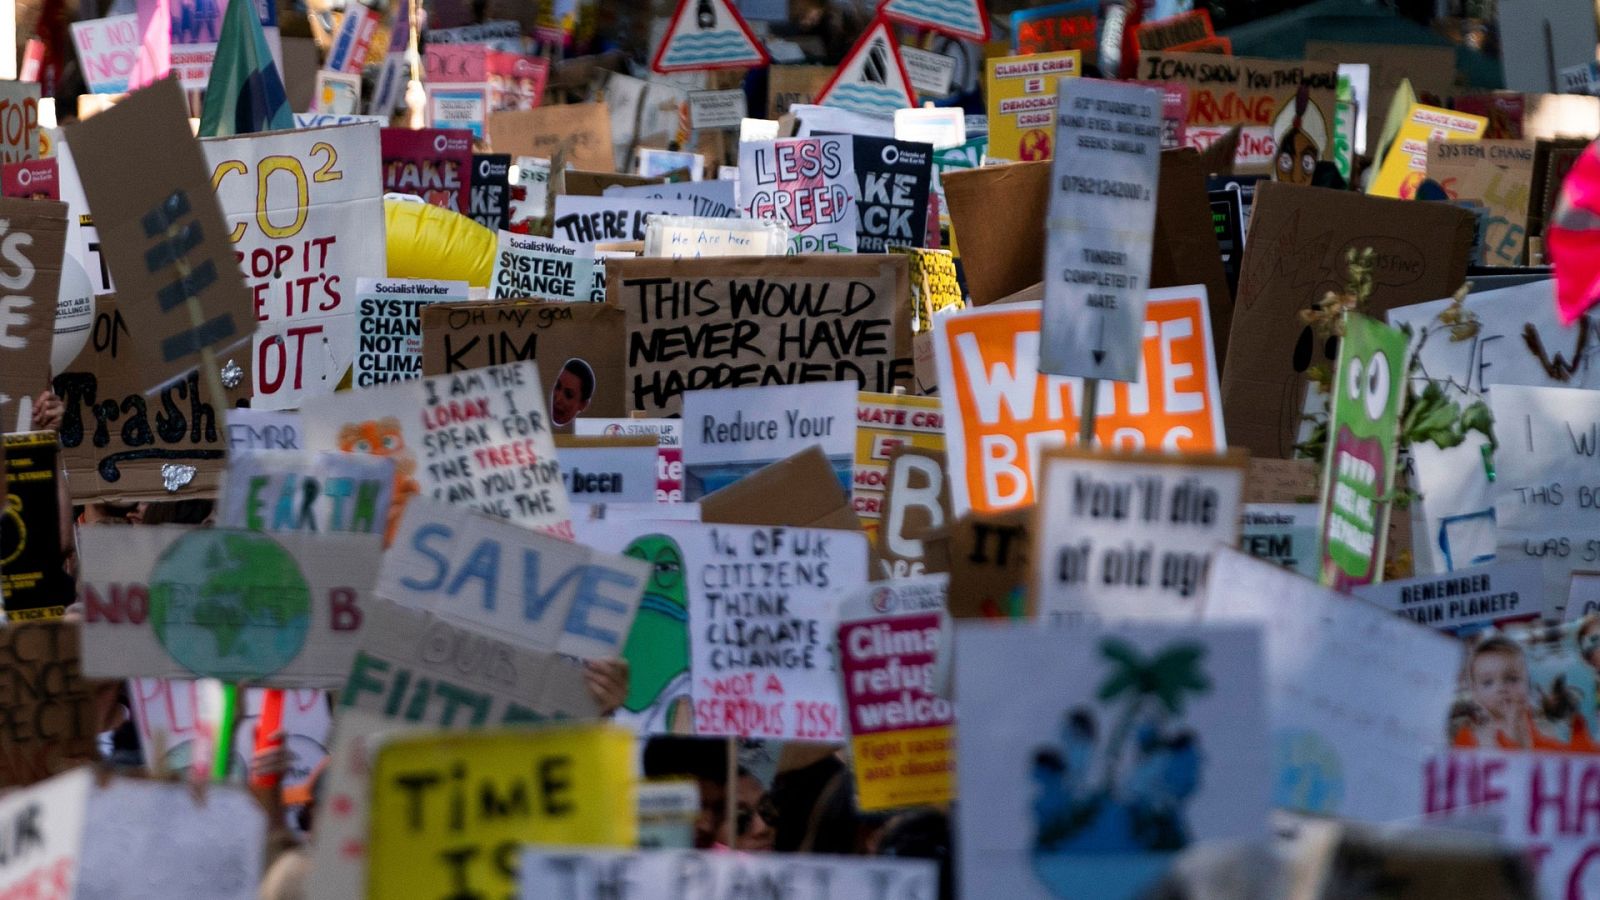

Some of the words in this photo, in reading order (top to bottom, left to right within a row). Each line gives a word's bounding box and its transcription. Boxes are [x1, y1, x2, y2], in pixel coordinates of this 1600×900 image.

[996, 62, 1039, 76] CLIMATE
[1042, 59, 1074, 71] CRISIS
[756, 141, 842, 185] LESS
[1438, 144, 1486, 159] SYSTEM
[382, 159, 461, 188] TAKE
[750, 184, 849, 227] GREED
[556, 209, 629, 242] THERE
[303, 236, 336, 272] IT
[500, 251, 573, 278] SYSTEM
[285, 273, 342, 318] IT'S
[375, 282, 416, 294] Socialist
[415, 284, 449, 295] Worker
[498, 269, 576, 297] CHANGE
[623, 278, 721, 324] THIS
[730, 278, 876, 320] WOULD
[360, 336, 403, 354] NOT
[444, 330, 539, 374] KIM
[629, 320, 765, 368] NEVER
[779, 318, 892, 361] HAVE
[424, 380, 440, 406] I
[450, 373, 486, 398] AM
[487, 364, 525, 388] THE
[53, 370, 218, 448] Trash
[504, 390, 519, 415] I
[424, 424, 491, 458] SPEAK
[502, 410, 546, 438] FOR
[628, 424, 658, 434] STAND
[660, 424, 674, 434] UP
[702, 410, 778, 444] Reduce
[785, 409, 835, 439] Your
[428, 456, 473, 482] THE
[482, 469, 517, 496] YOU
[518, 459, 559, 489] STOP
[571, 467, 623, 493] been
[246, 473, 382, 532] EARTH
[514, 488, 556, 517] THE
[1169, 475, 1219, 526] die
[1512, 483, 1565, 506] THIS
[752, 527, 787, 556] OF
[1523, 537, 1571, 560] WAS
[400, 523, 640, 647] SAVE
[703, 561, 830, 589] CITIZENS
[1401, 573, 1492, 605] REMEMBER
[84, 581, 148, 624] NO
[328, 587, 363, 631] B
[706, 592, 790, 618] THINK
[1449, 590, 1520, 620] PLANET?
[706, 618, 819, 647] CLIMATE
[710, 645, 817, 671] CHANGE
[703, 671, 755, 697] NOT
[765, 673, 785, 697] A
[696, 698, 784, 737] SERIOUS
